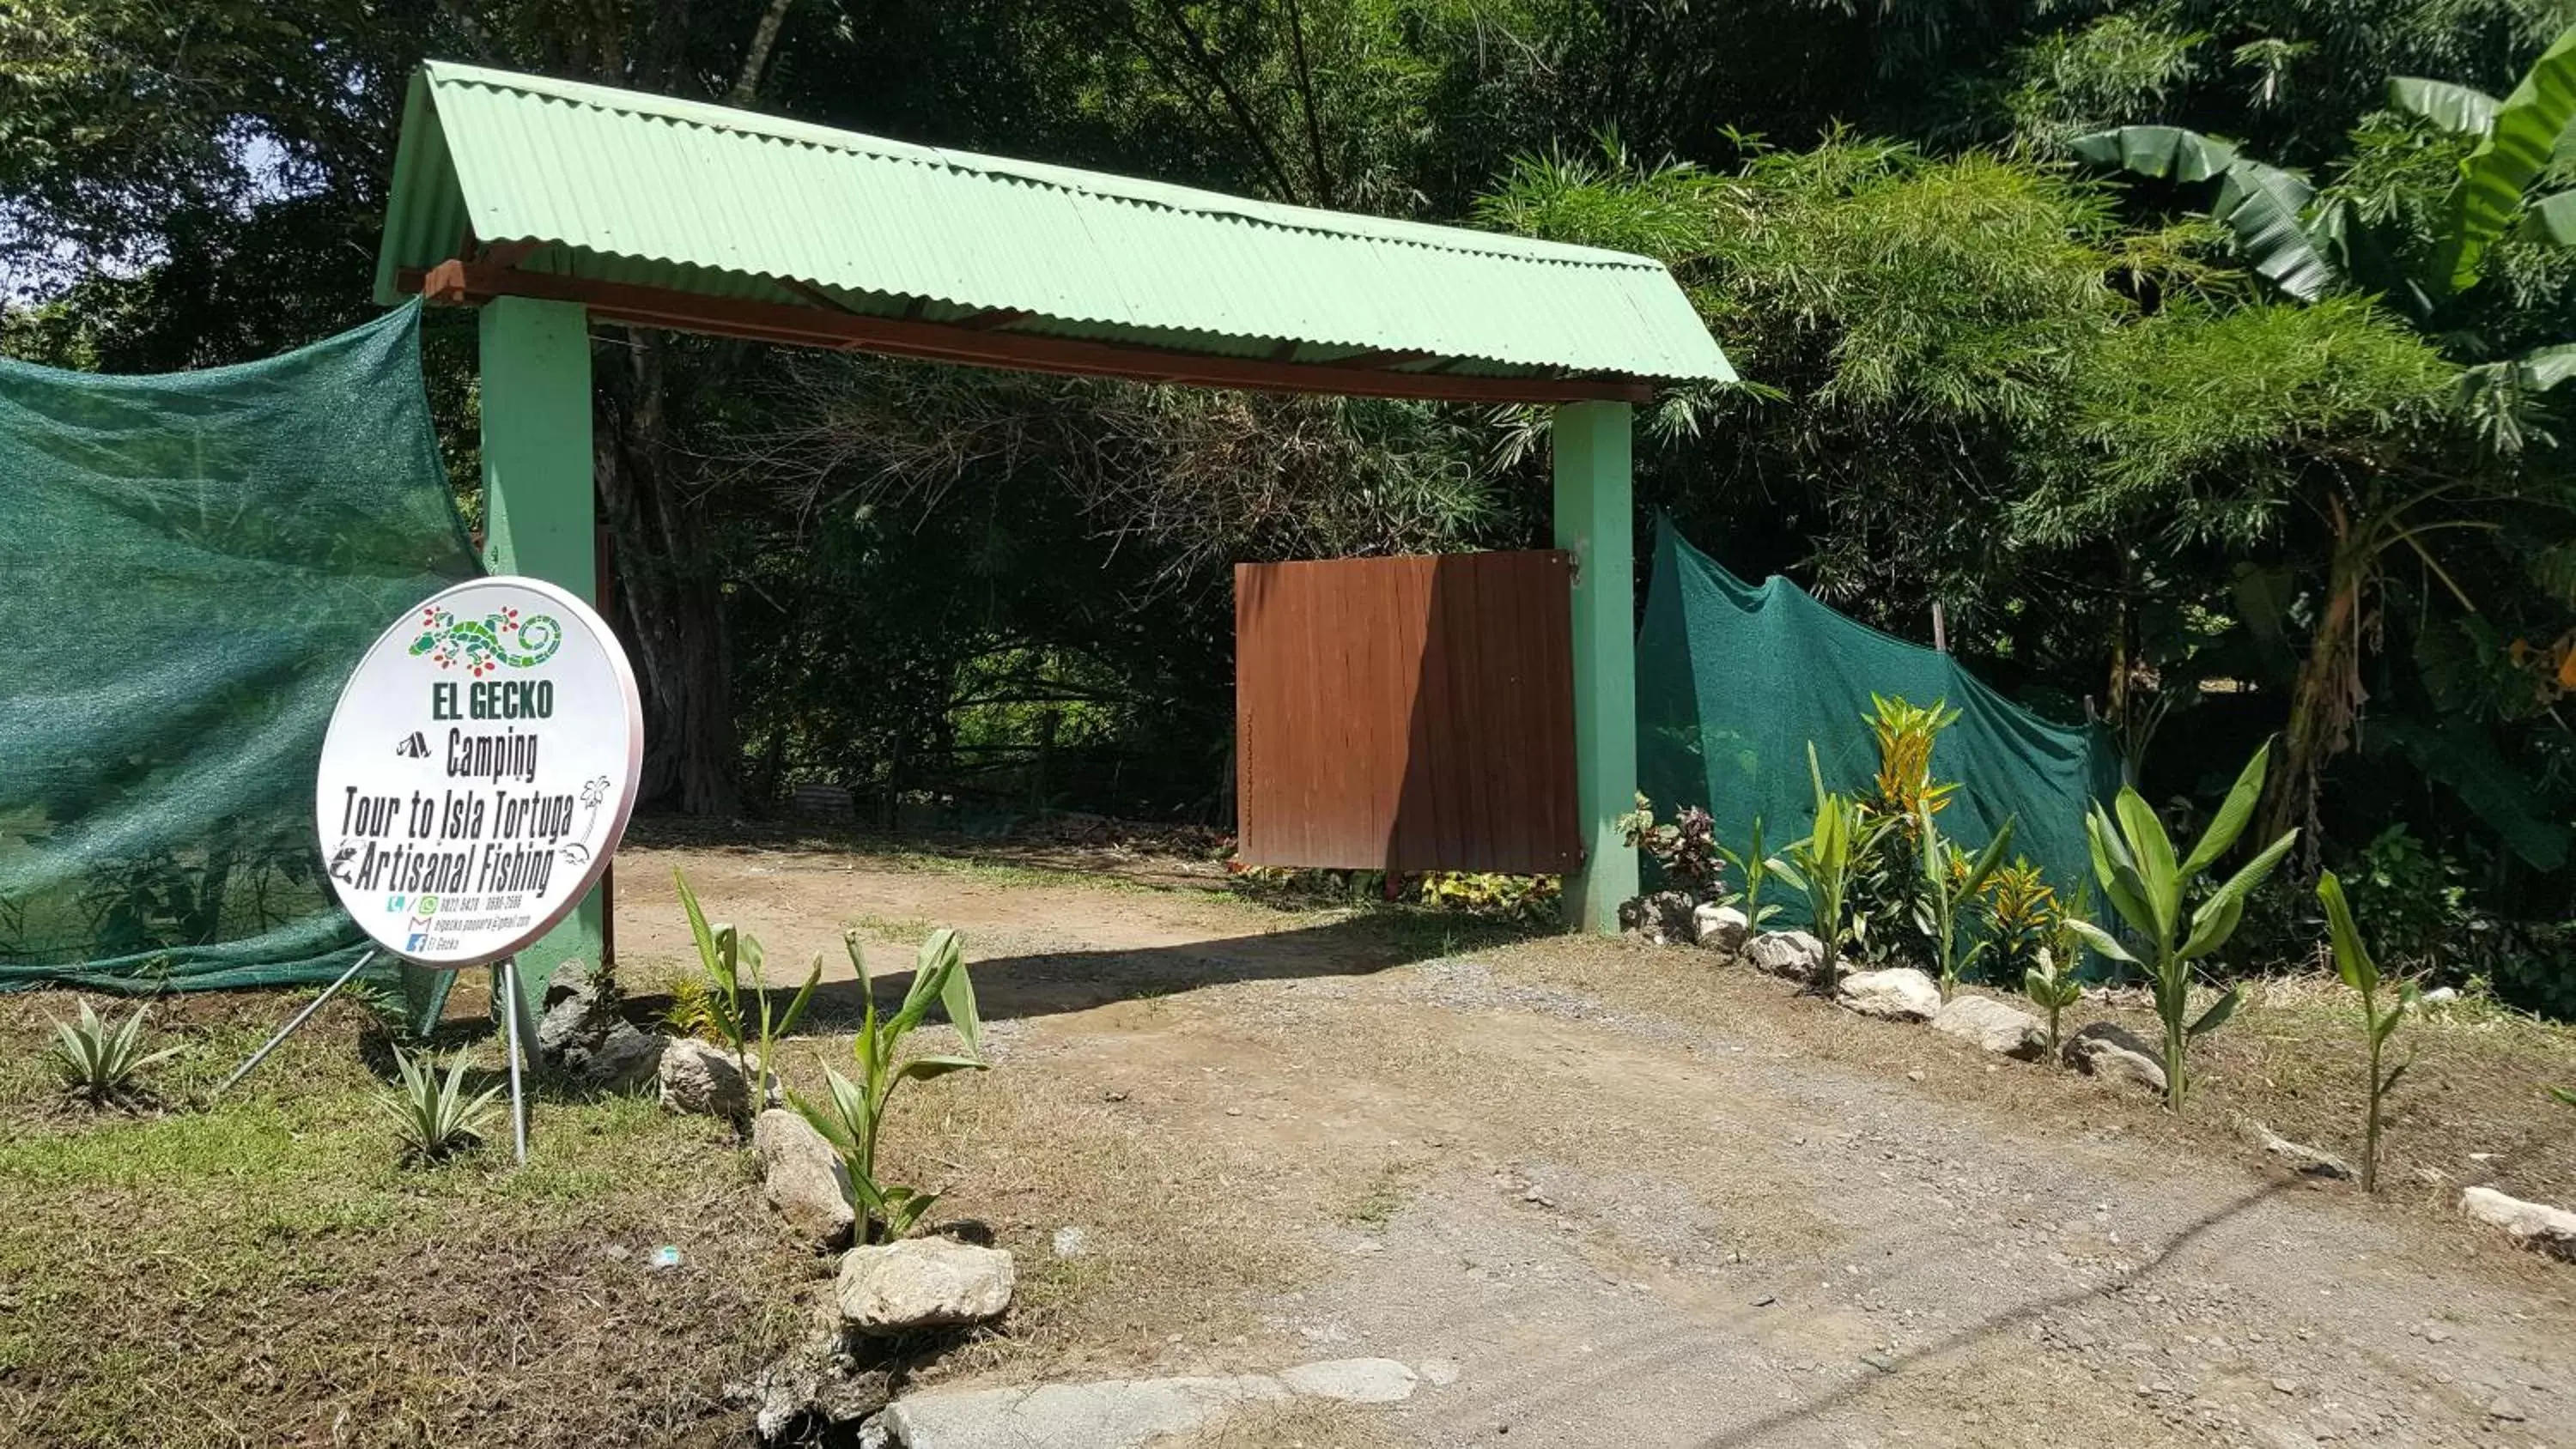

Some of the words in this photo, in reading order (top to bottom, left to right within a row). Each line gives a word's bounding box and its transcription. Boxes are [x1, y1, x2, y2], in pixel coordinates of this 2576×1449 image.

[433, 682, 464, 720] EL
[471, 680, 554, 719] GECKO
[447, 726, 538, 785] Camping
[341, 786, 400, 838] Tour
[409, 790, 434, 839] to
[440, 790, 485, 840] Isla
[493, 791, 574, 845] Tortuga
[355, 841, 476, 894] Artisanal
[477, 842, 555, 898] Fishing
